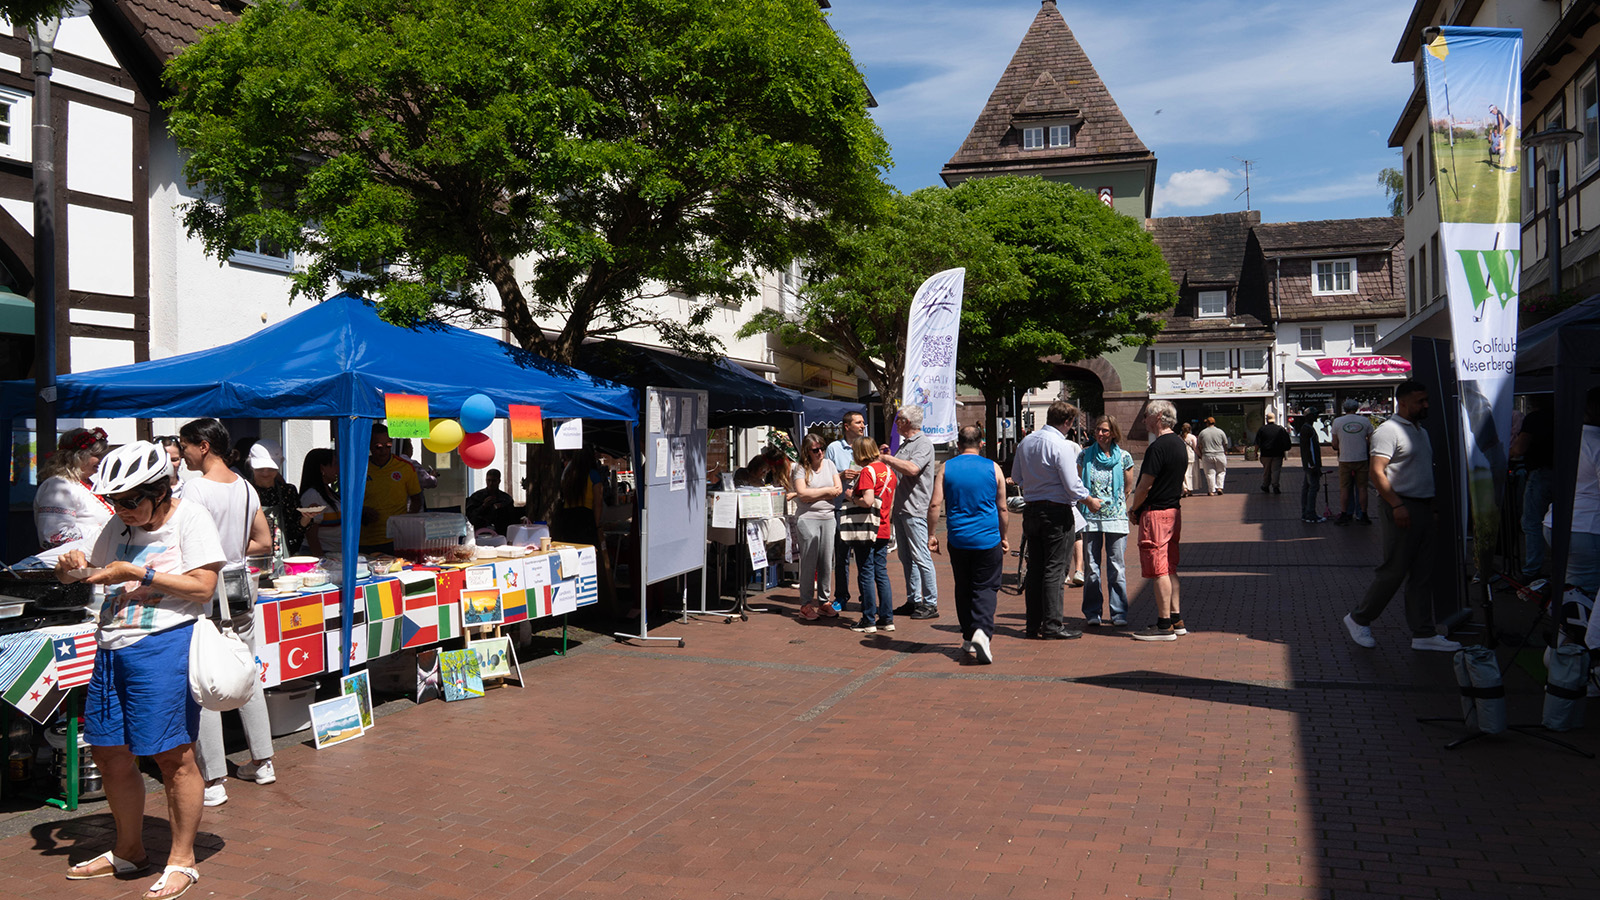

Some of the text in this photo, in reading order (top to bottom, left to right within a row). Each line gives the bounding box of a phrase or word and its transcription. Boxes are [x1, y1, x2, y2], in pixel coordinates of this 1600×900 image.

[1332, 358, 1355, 367] Mia's
[1185, 379, 1235, 389] UmWeltladen
[920, 424, 945, 434] konie
